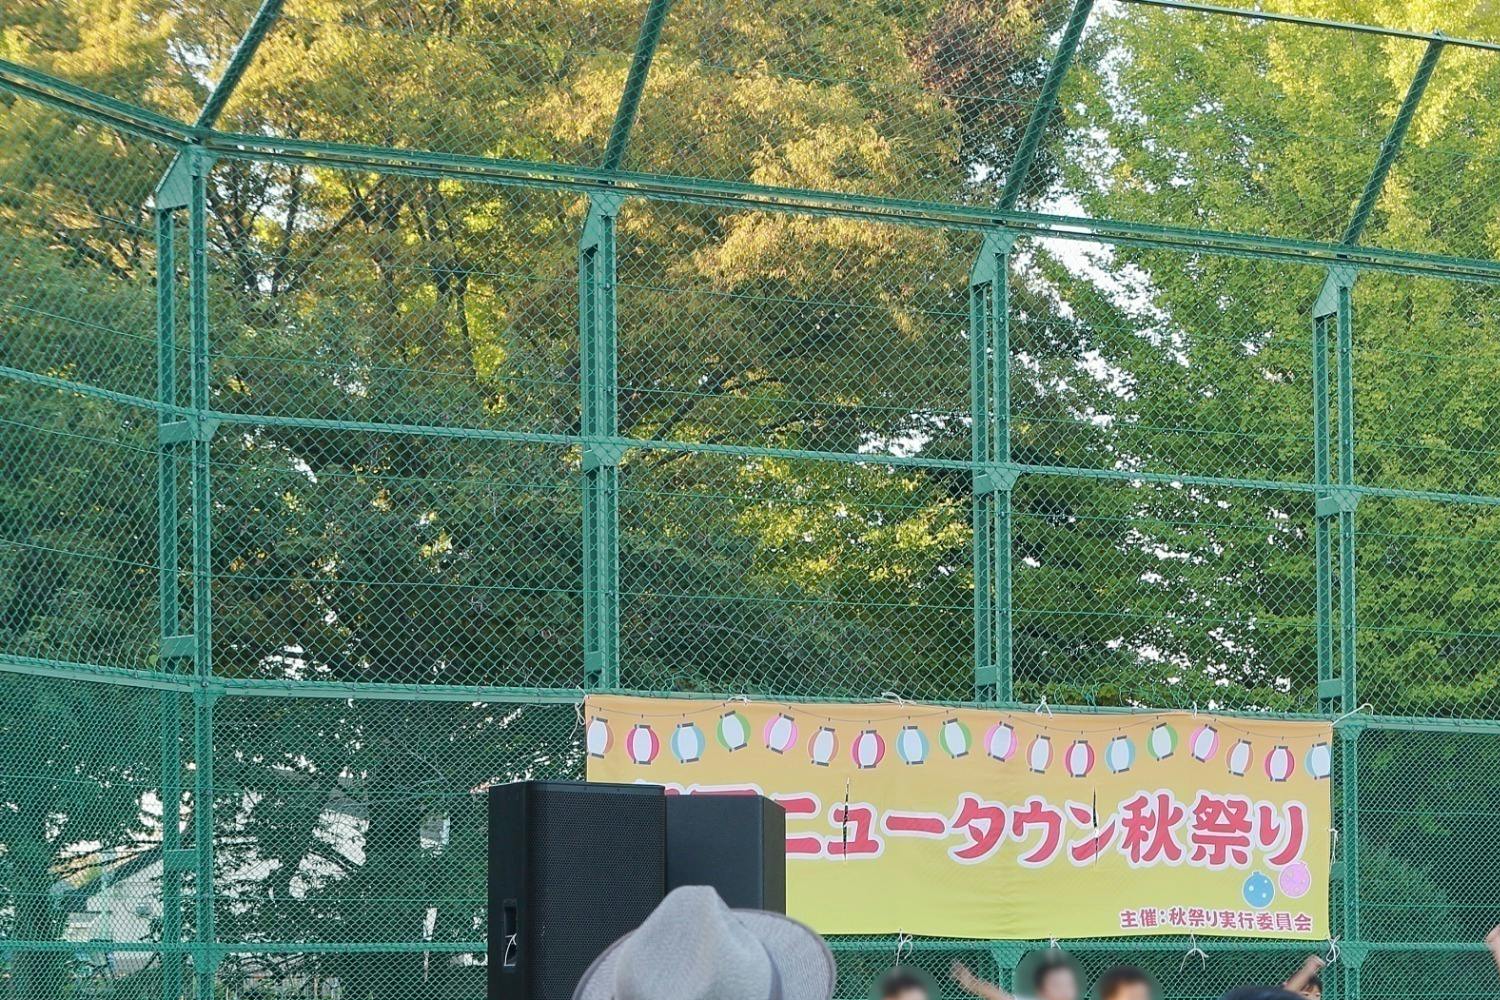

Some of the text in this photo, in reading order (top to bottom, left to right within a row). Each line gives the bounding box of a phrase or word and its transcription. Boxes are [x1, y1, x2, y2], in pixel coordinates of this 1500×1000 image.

[634, 785, 1304, 866] ニュータウン秋祭り
[1121, 907, 1311, 931] 主催：秋祭り実行委員会
